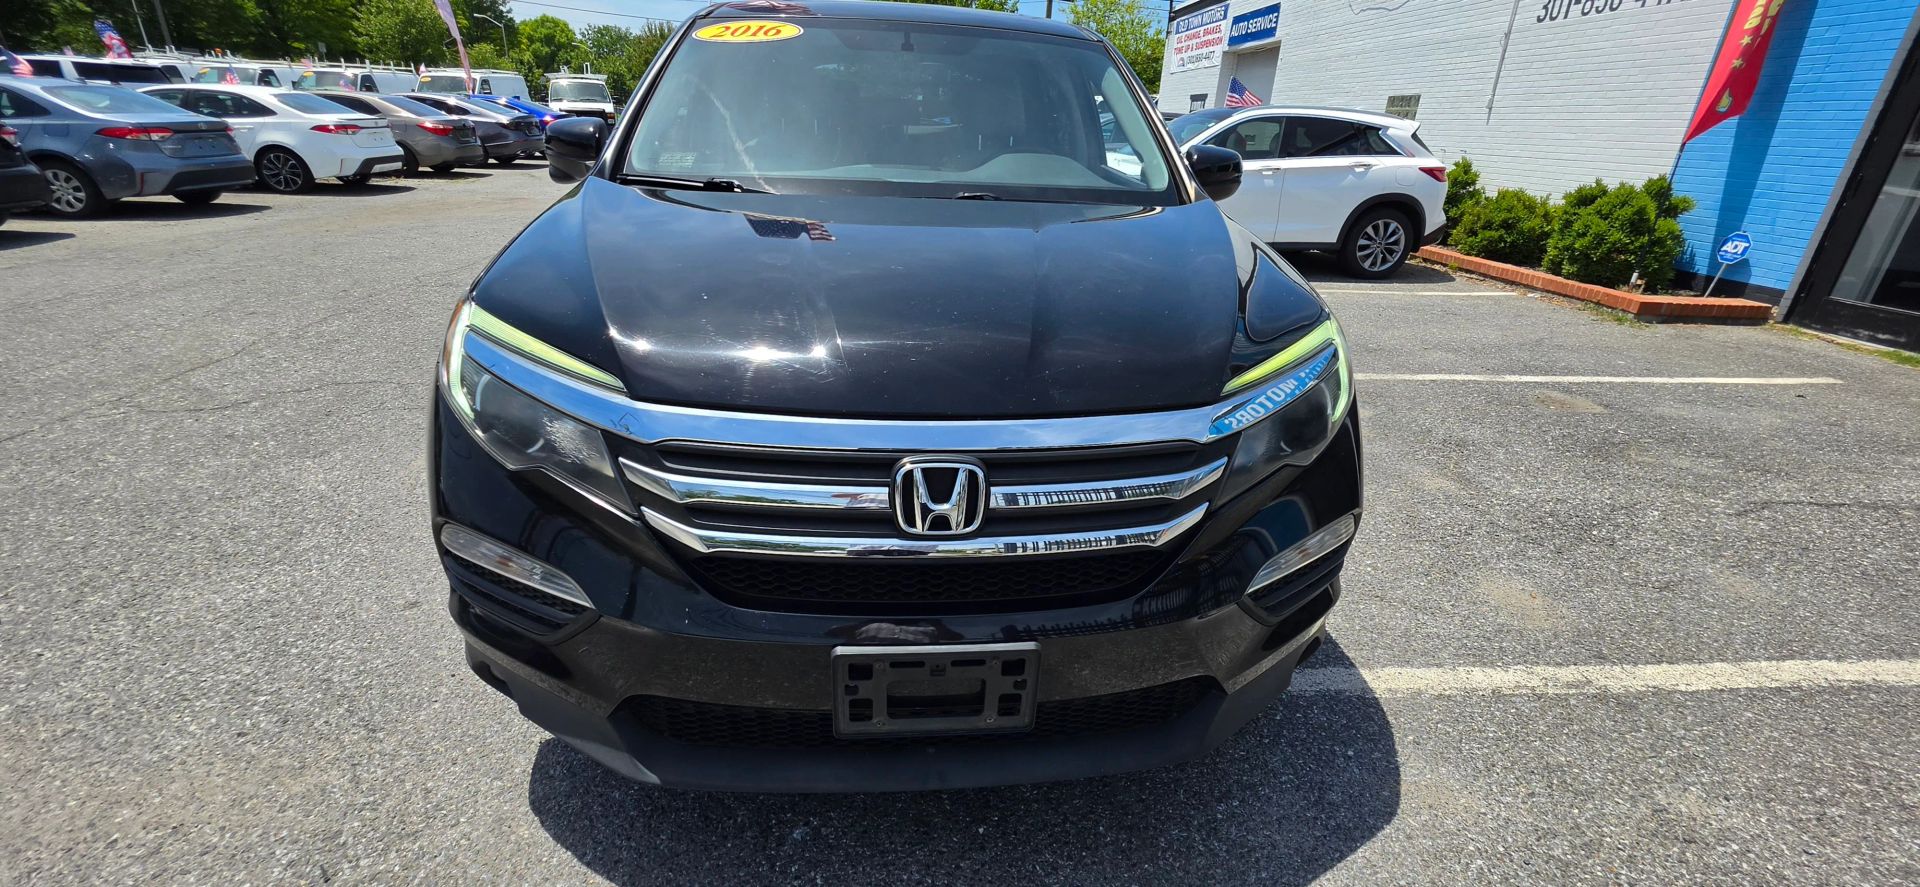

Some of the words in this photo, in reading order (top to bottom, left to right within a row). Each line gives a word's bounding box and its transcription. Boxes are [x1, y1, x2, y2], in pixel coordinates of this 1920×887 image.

[709, 24, 787, 39] 2016
[1231, 22, 1248, 37] AUTO
[1248, 13, 1278, 33] SERVICE
[1721, 240, 1750, 254] ADT
